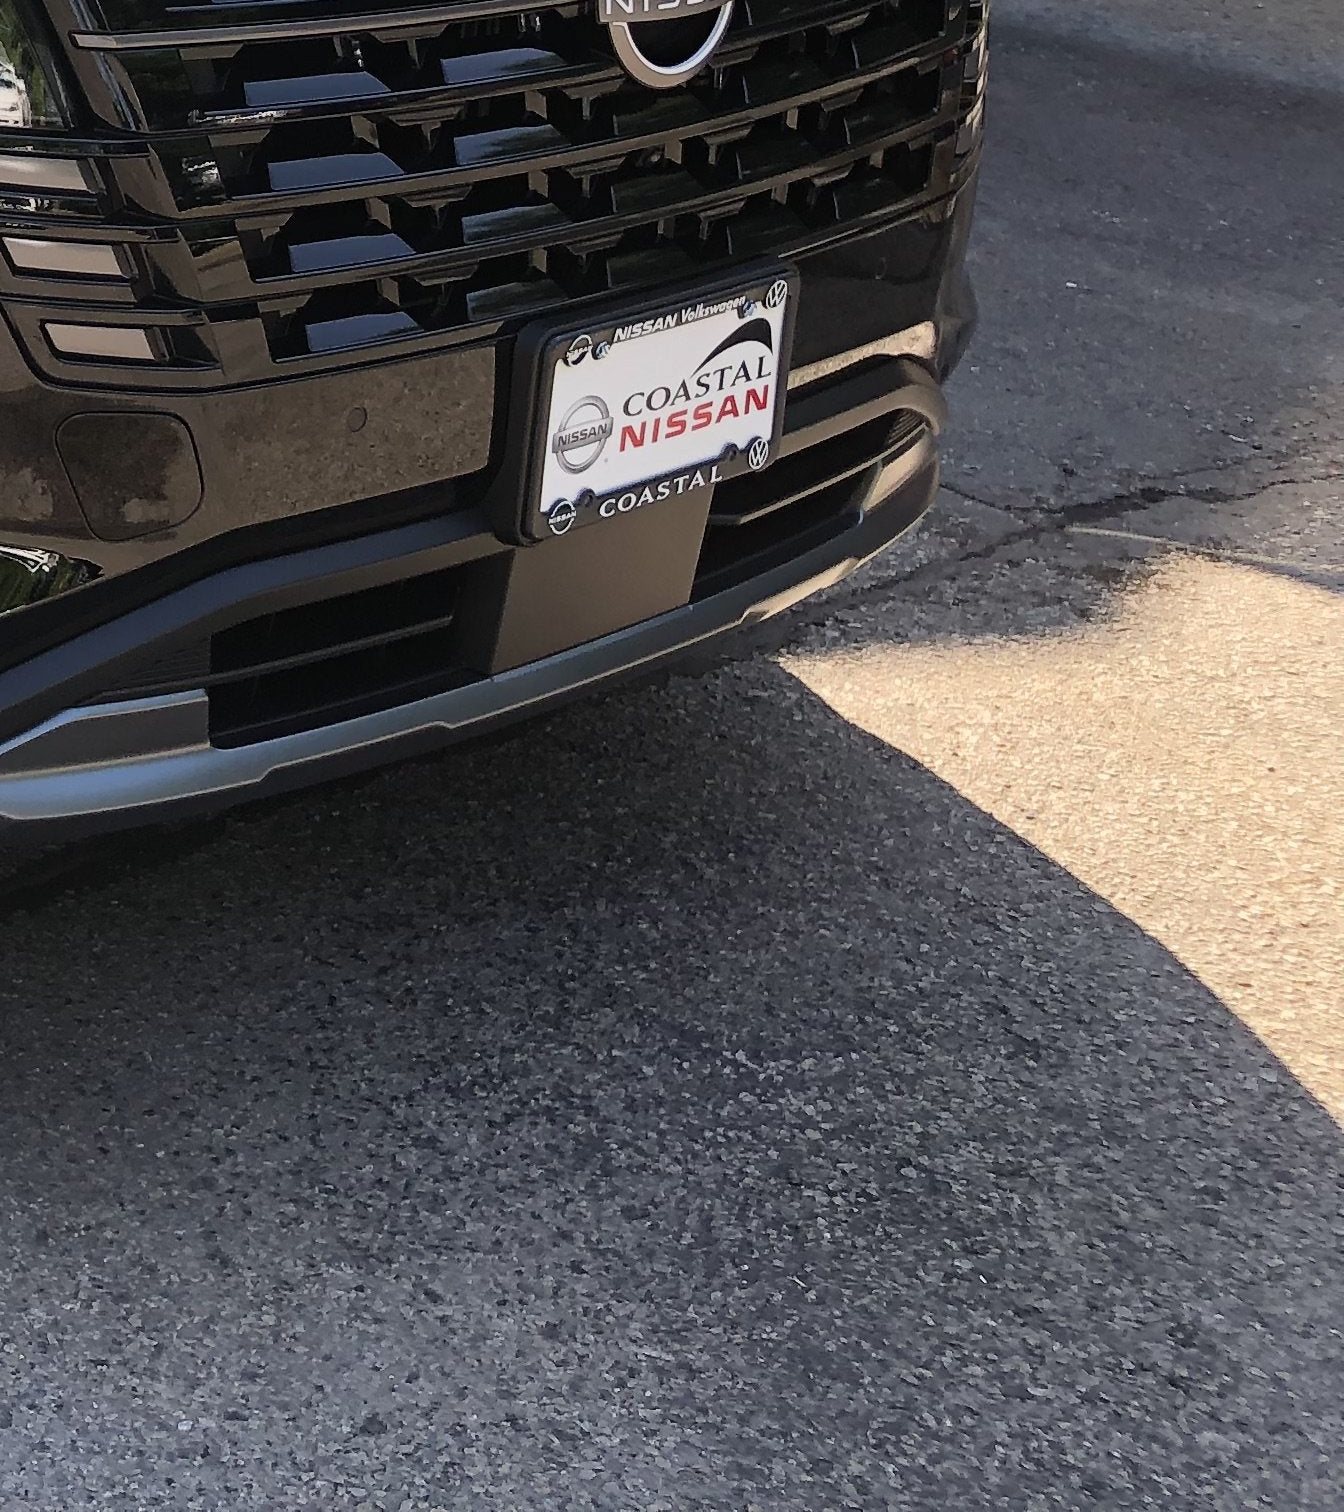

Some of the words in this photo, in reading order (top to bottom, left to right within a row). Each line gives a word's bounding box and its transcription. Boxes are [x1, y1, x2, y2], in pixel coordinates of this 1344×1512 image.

[613, 312, 678, 342] NISSAN
[680, 296, 746, 324] Volkswagen
[622, 355, 772, 417] COASTAL
[557, 423, 609, 448] NISSAN
[618, 384, 770, 453] NISSAN
[599, 465, 723, 518] COASTAL
